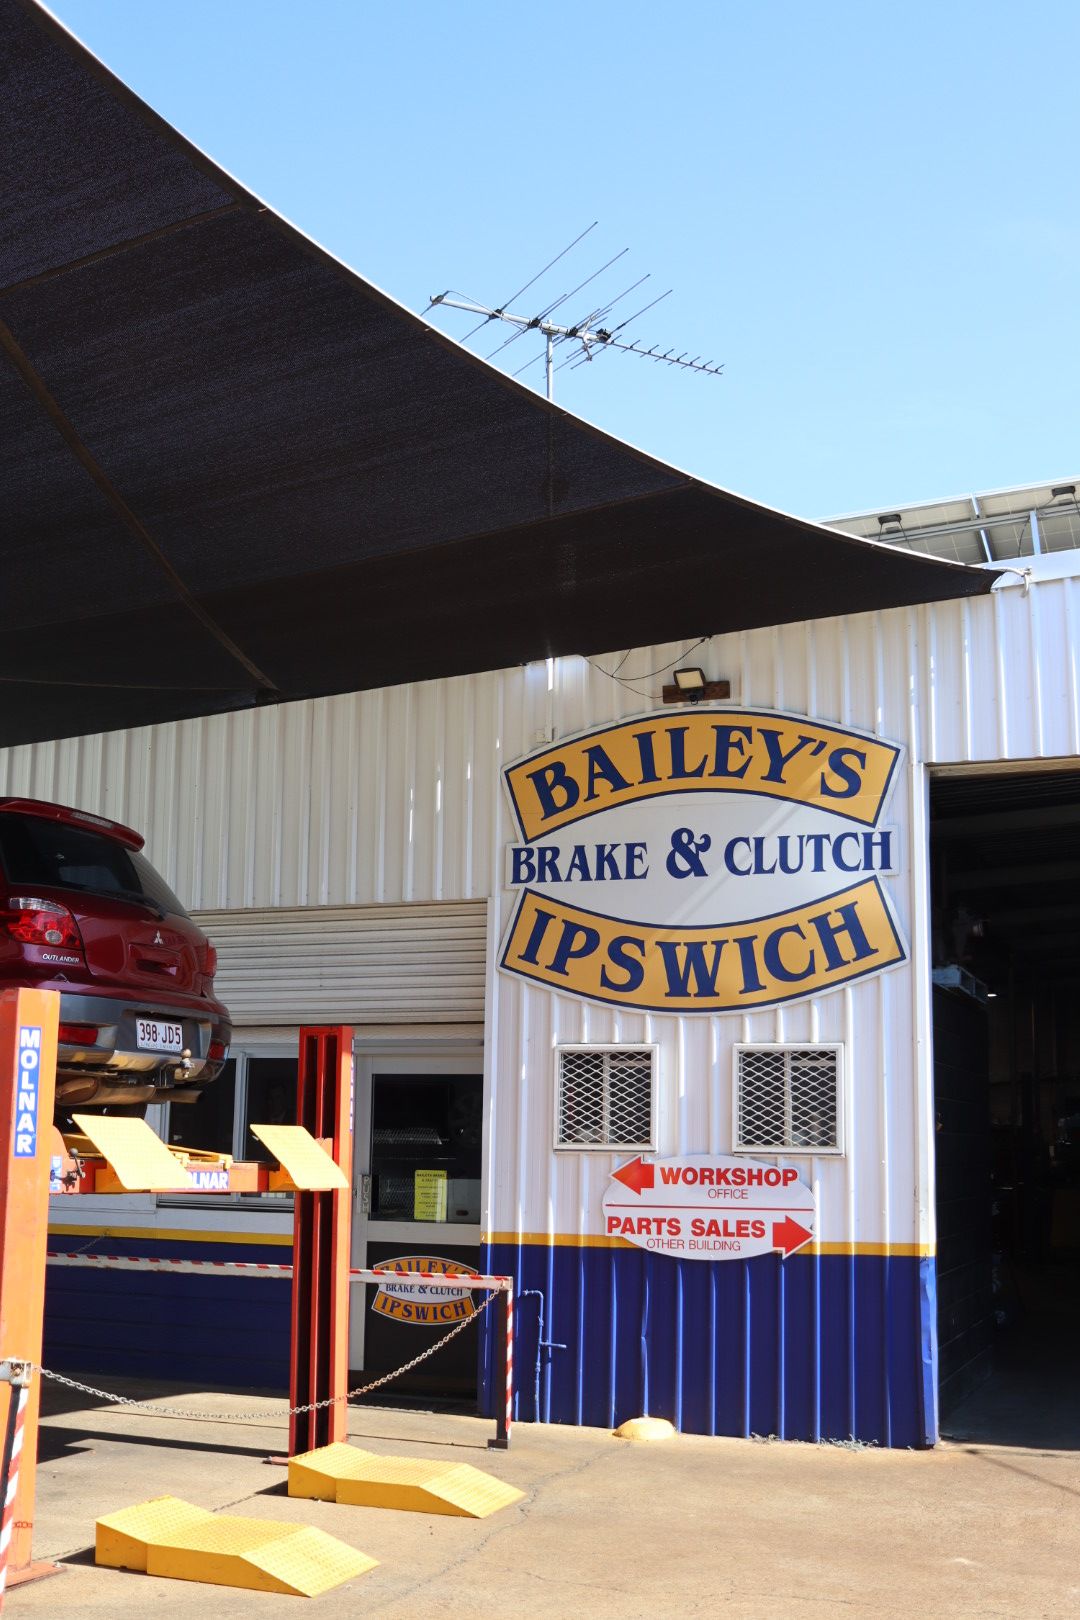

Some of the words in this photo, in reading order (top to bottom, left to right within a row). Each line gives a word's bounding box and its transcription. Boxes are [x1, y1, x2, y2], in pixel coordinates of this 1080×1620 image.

[526, 724, 867, 822] BAILEY'S
[510, 842, 649, 884] BRAKE
[665, 827, 712, 880] &
[723, 831, 893, 876] CLUTCH
[42, 953, 80, 963] OUTLANDER
[517, 901, 879, 998] IPSWICH
[16, 1029, 41, 1153] MOLNAR
[660, 1167, 798, 1186] WORKSHOP
[708, 1188, 748, 1200] OFFICE
[607, 1216, 682, 1236] PARTS
[691, 1219, 766, 1238] SALES
[646, 1238, 685, 1250] OTHER
[688, 1240, 741, 1251] BUILDING
[386, 1283, 415, 1294] BRAKE
[418, 1285, 428, 1294] &
[430, 1286, 463, 1297] CLUTCH
[381, 1297, 467, 1320] IPSWICH
